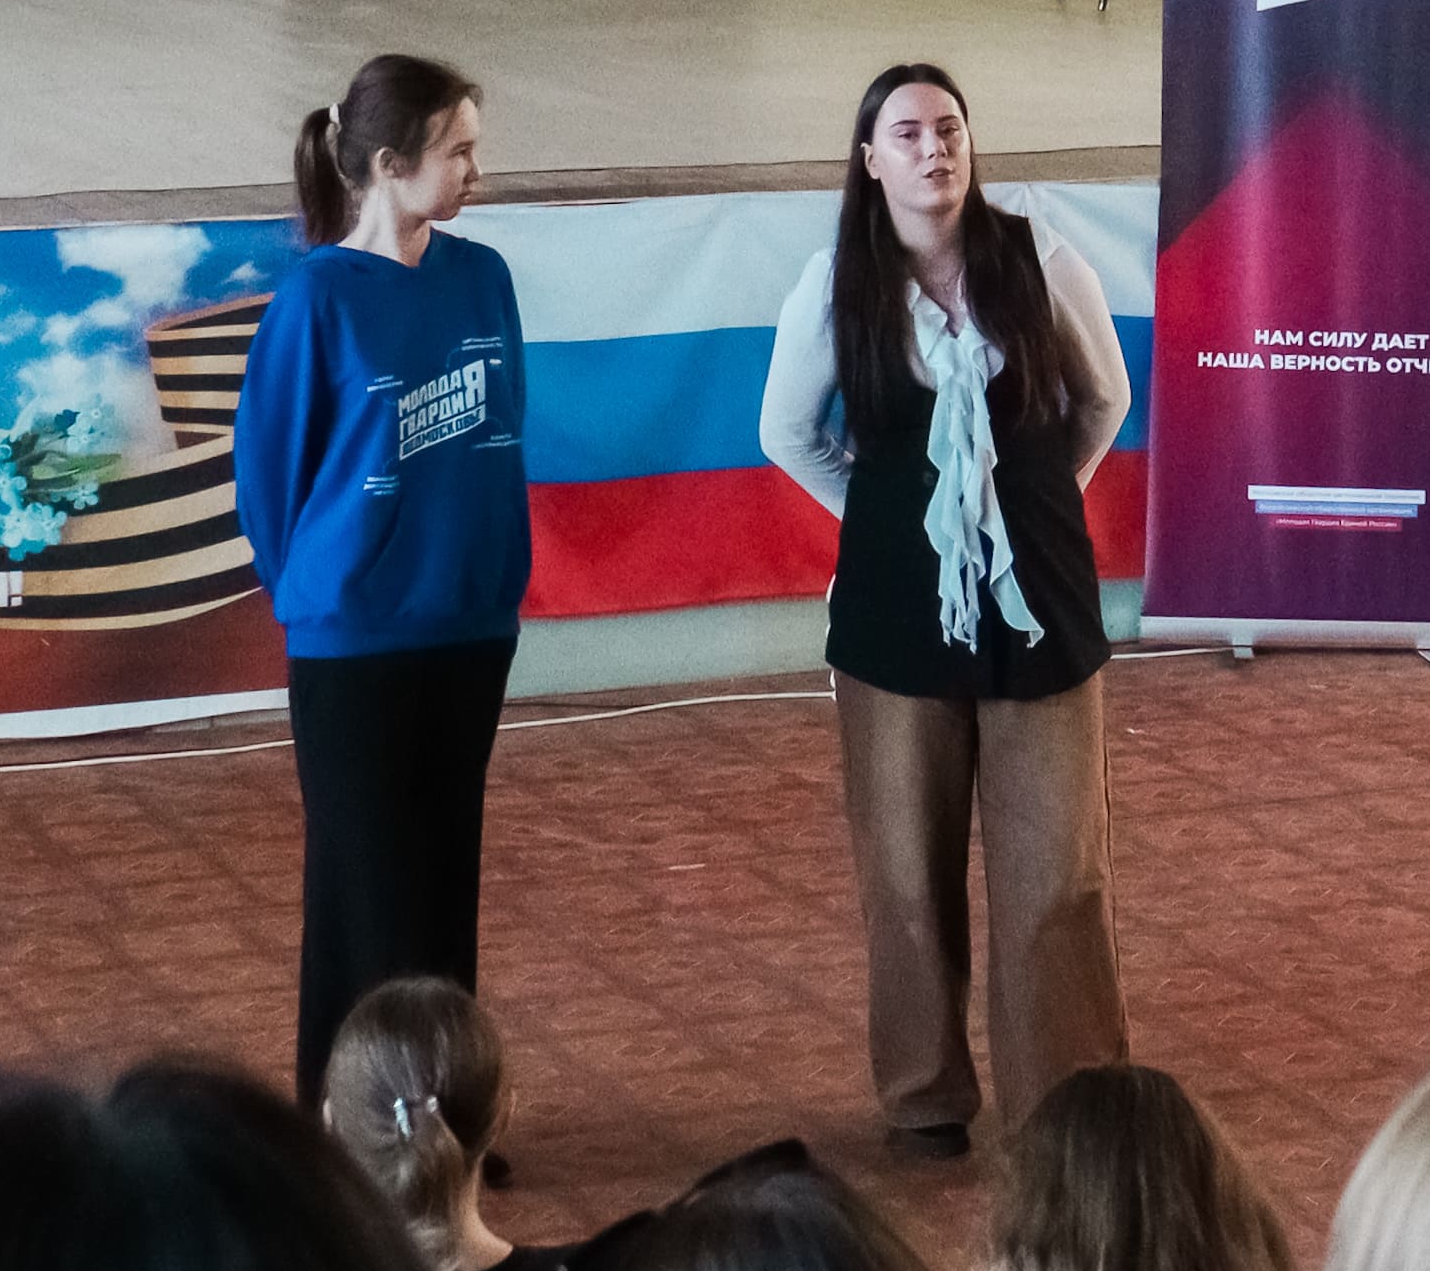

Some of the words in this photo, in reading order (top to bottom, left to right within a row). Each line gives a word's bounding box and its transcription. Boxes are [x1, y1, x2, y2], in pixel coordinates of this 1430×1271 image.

[1254, 328, 1304, 346] НАМ
[1308, 330, 1368, 349] СИЛУ
[1371, 332, 1430, 351] ДАЕТ
[1197, 351, 1265, 370] НАША
[1270, 353, 1382, 374] ВЕРНОСТЬ
[398, 358, 487, 418] МОЛОДАЯ
